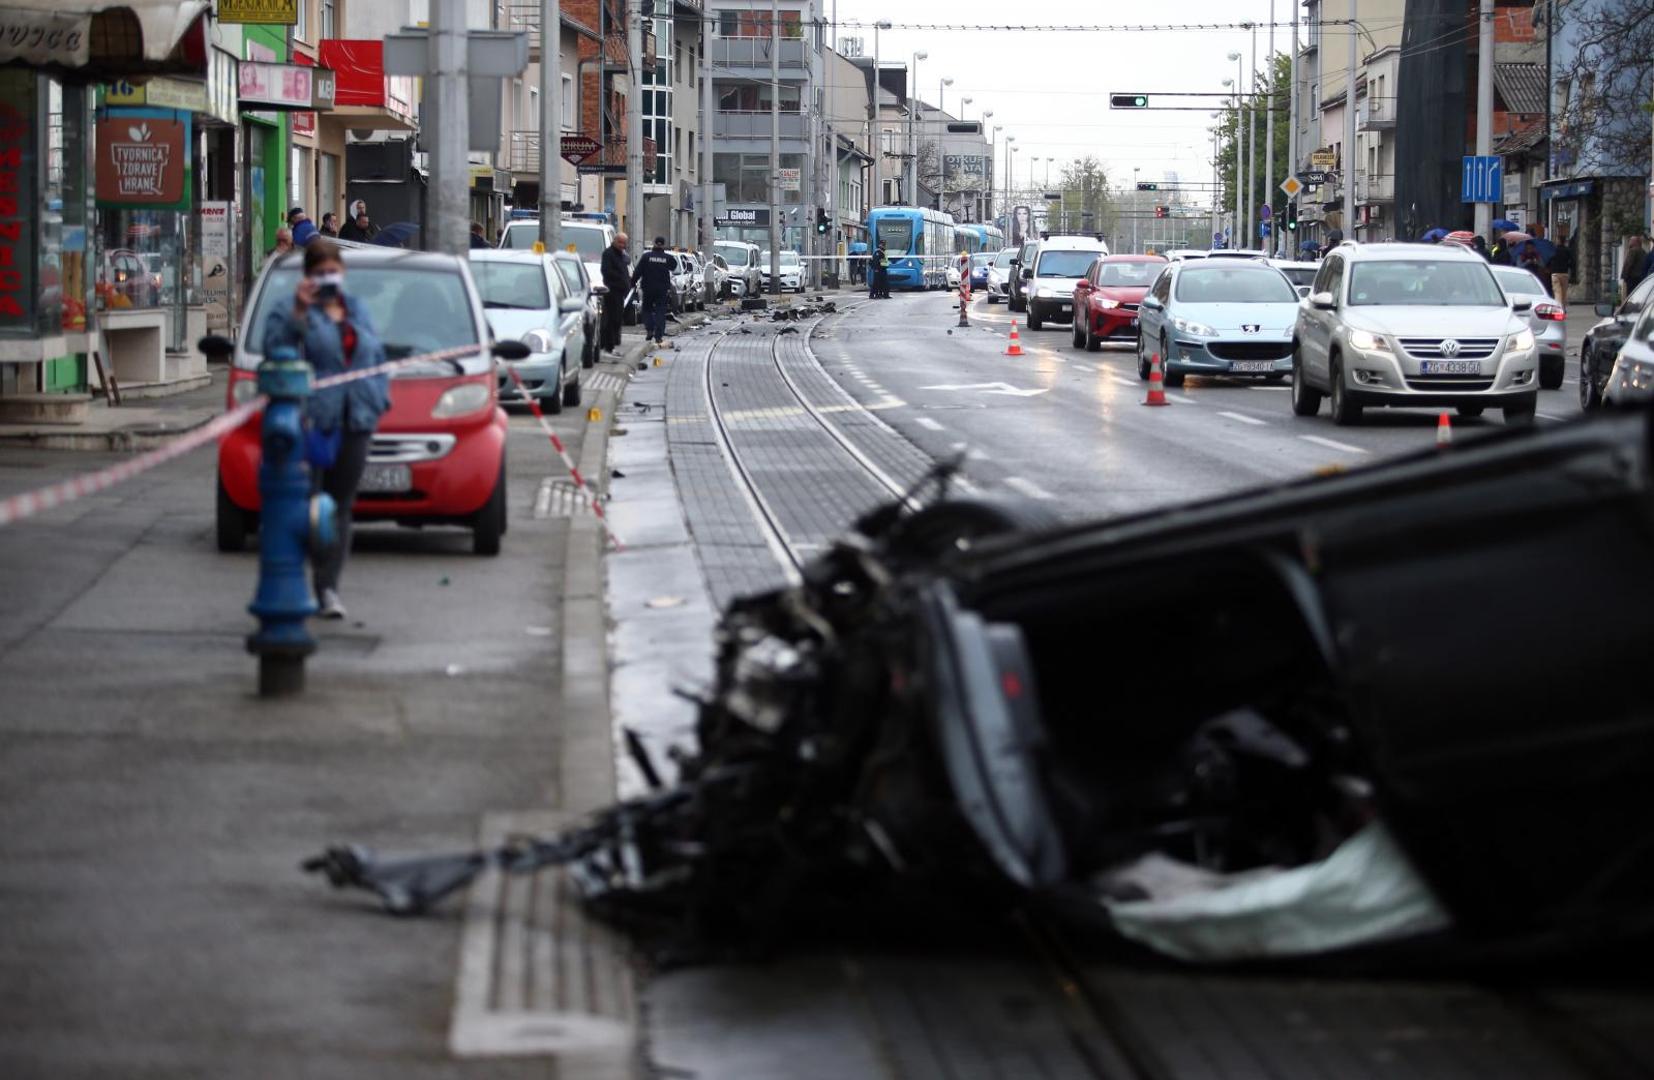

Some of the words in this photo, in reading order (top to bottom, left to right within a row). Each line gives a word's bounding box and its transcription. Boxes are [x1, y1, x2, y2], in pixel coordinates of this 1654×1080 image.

[117, 148, 163, 161] TVORNICA
[122, 163, 157, 176] ZDRAVE
[124, 177, 155, 190] HRANE
[730, 210, 756, 220] Global
